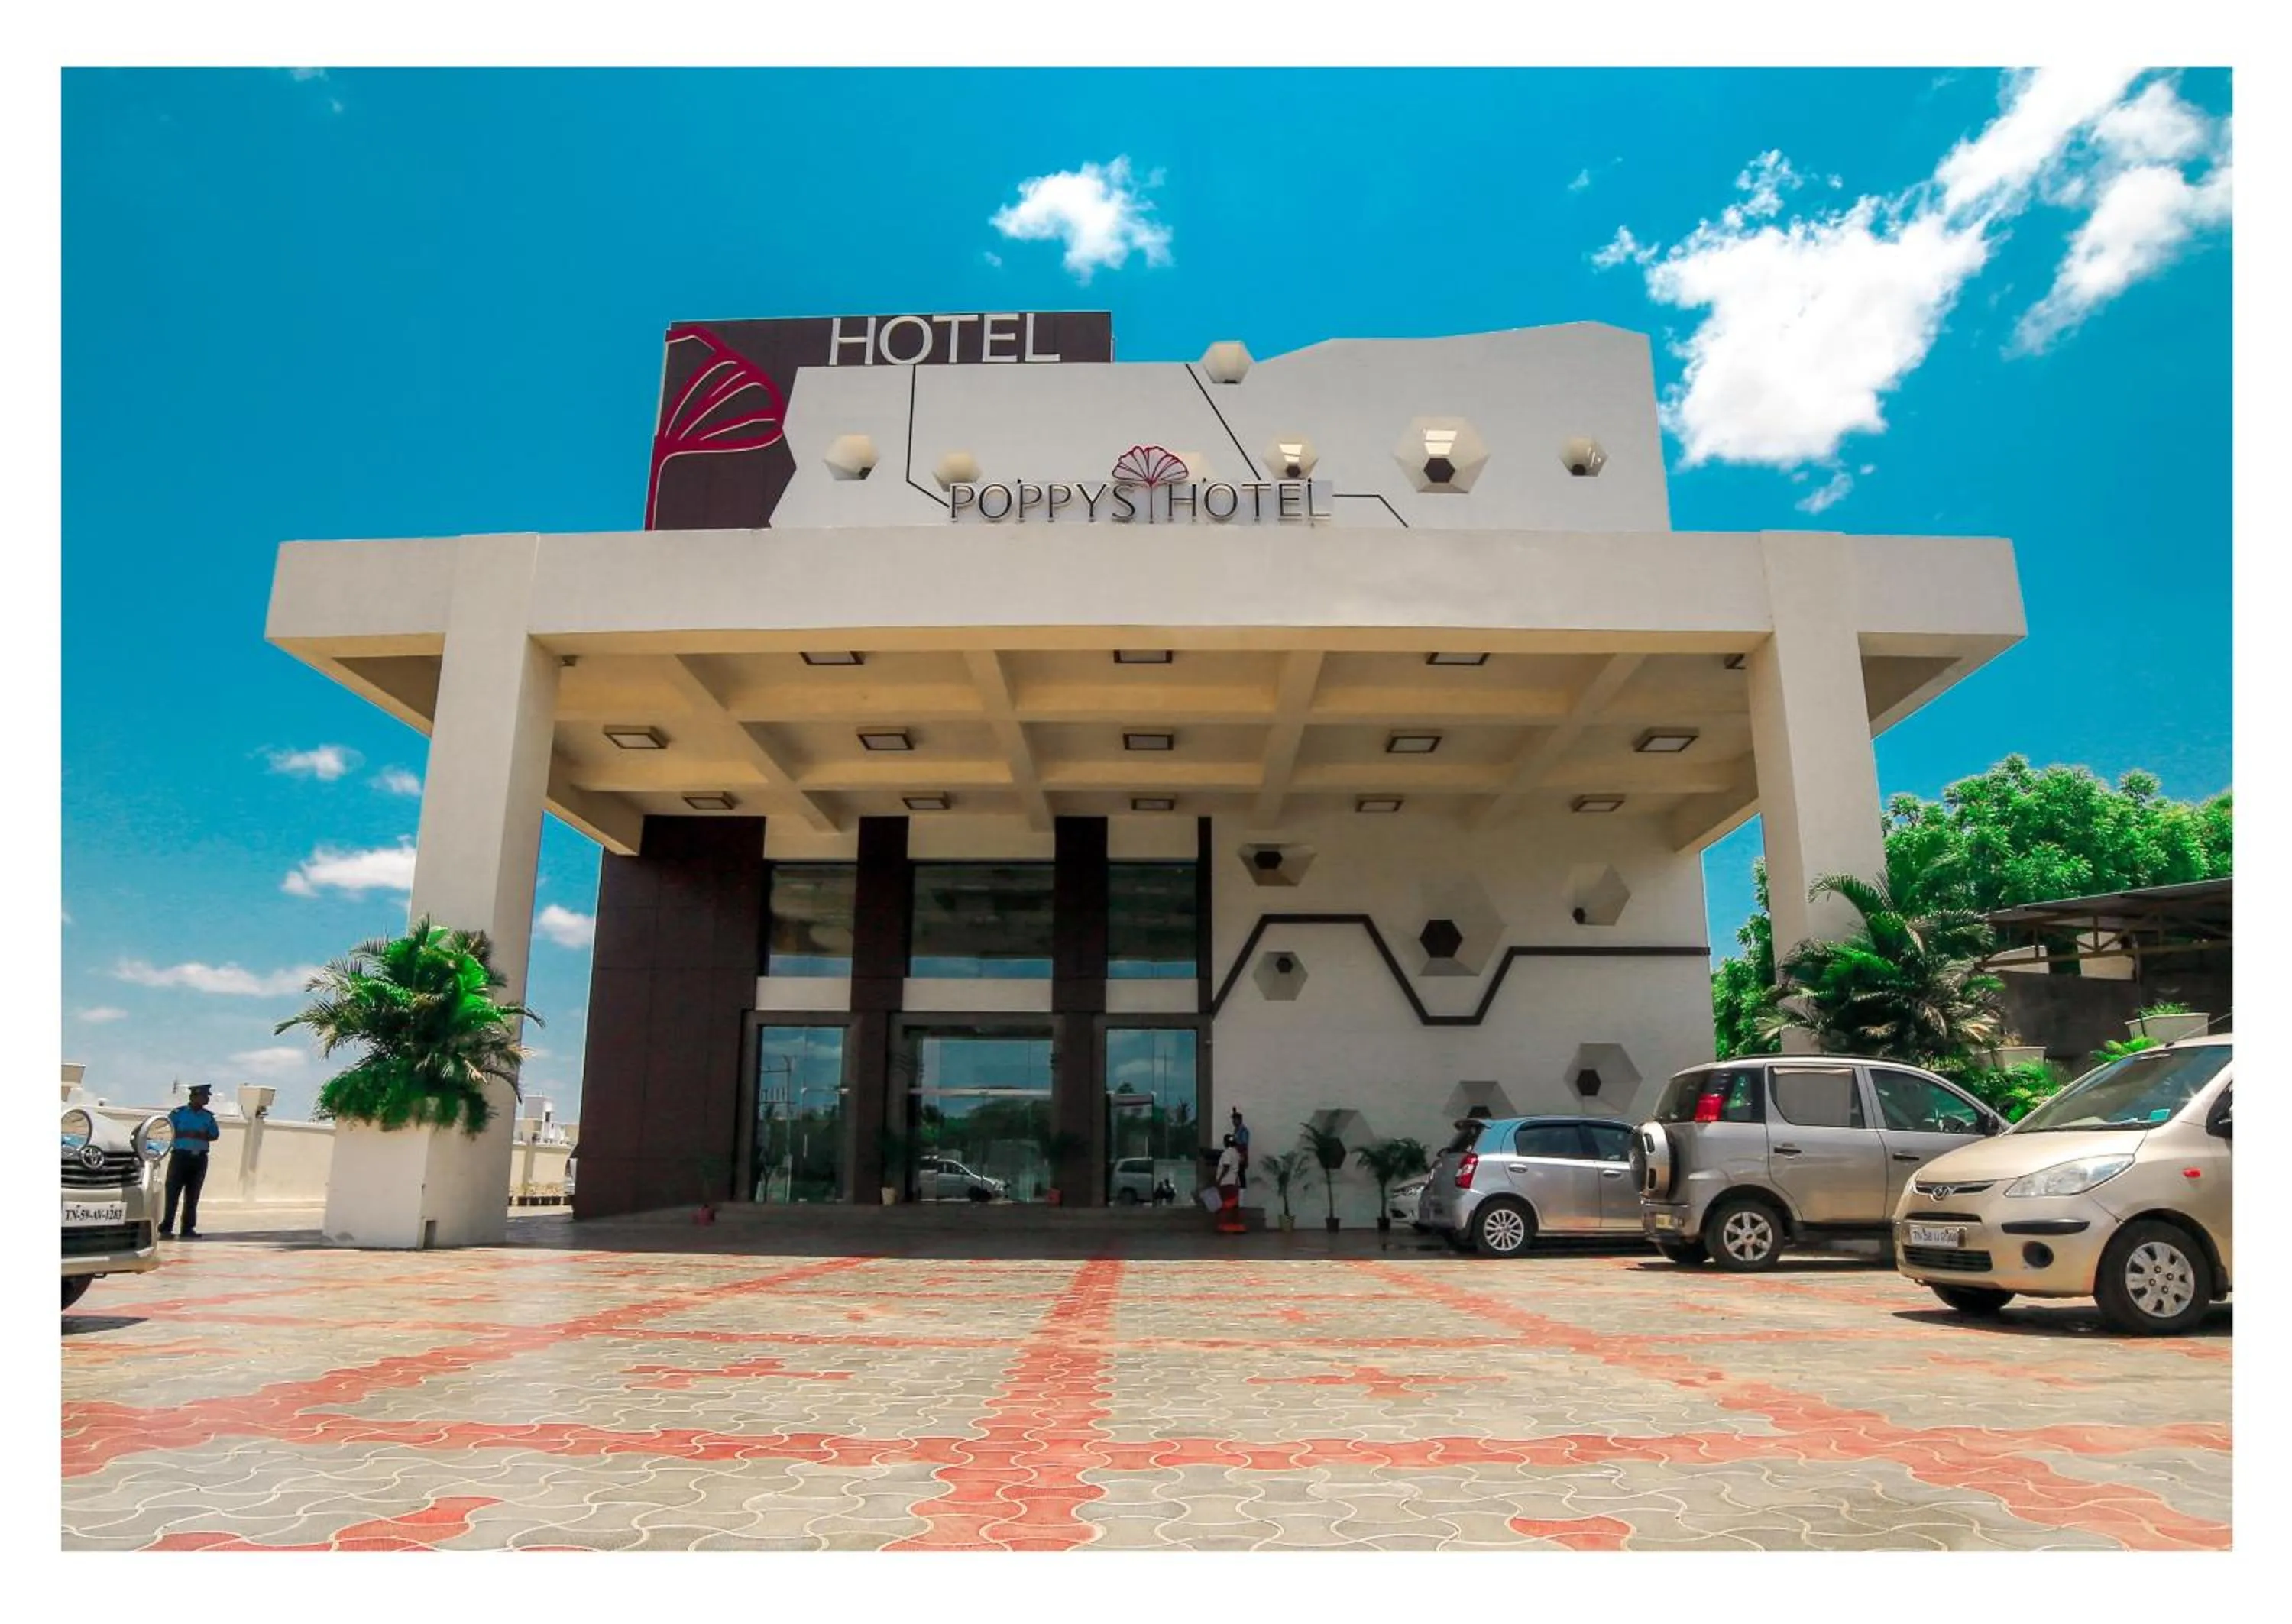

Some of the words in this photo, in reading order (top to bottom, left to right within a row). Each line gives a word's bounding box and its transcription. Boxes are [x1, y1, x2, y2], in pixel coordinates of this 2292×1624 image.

[829, 313, 1061, 366] HOTEL
[950, 482, 1137, 522] POPPYS
[1167, 482, 1332, 522] HOTEL
